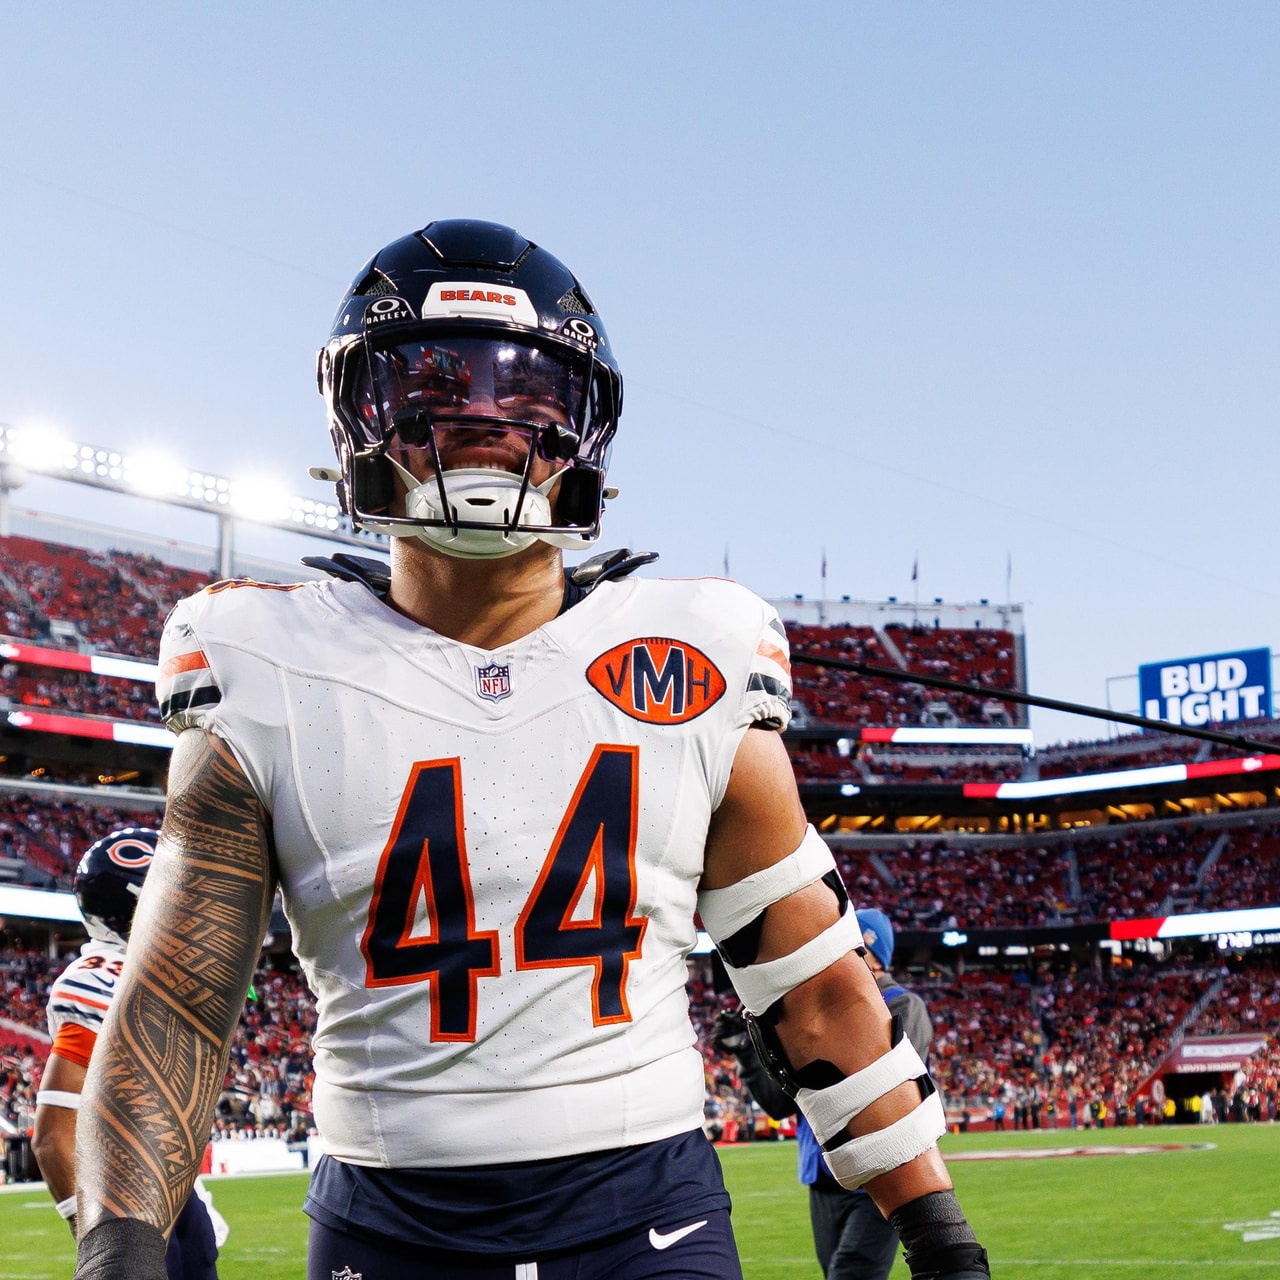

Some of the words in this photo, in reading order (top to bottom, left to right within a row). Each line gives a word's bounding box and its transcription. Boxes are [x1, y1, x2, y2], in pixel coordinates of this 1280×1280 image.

[440, 290, 517, 306] BEARS
[366, 310, 408, 325] OAKLEY
[563, 327, 598, 350] OAKLEY
[481, 675, 511, 695] NFL
[1161, 658, 1247, 698] BUD
[1146, 685, 1265, 726] LIGHT
[361, 743, 648, 1043] 44
